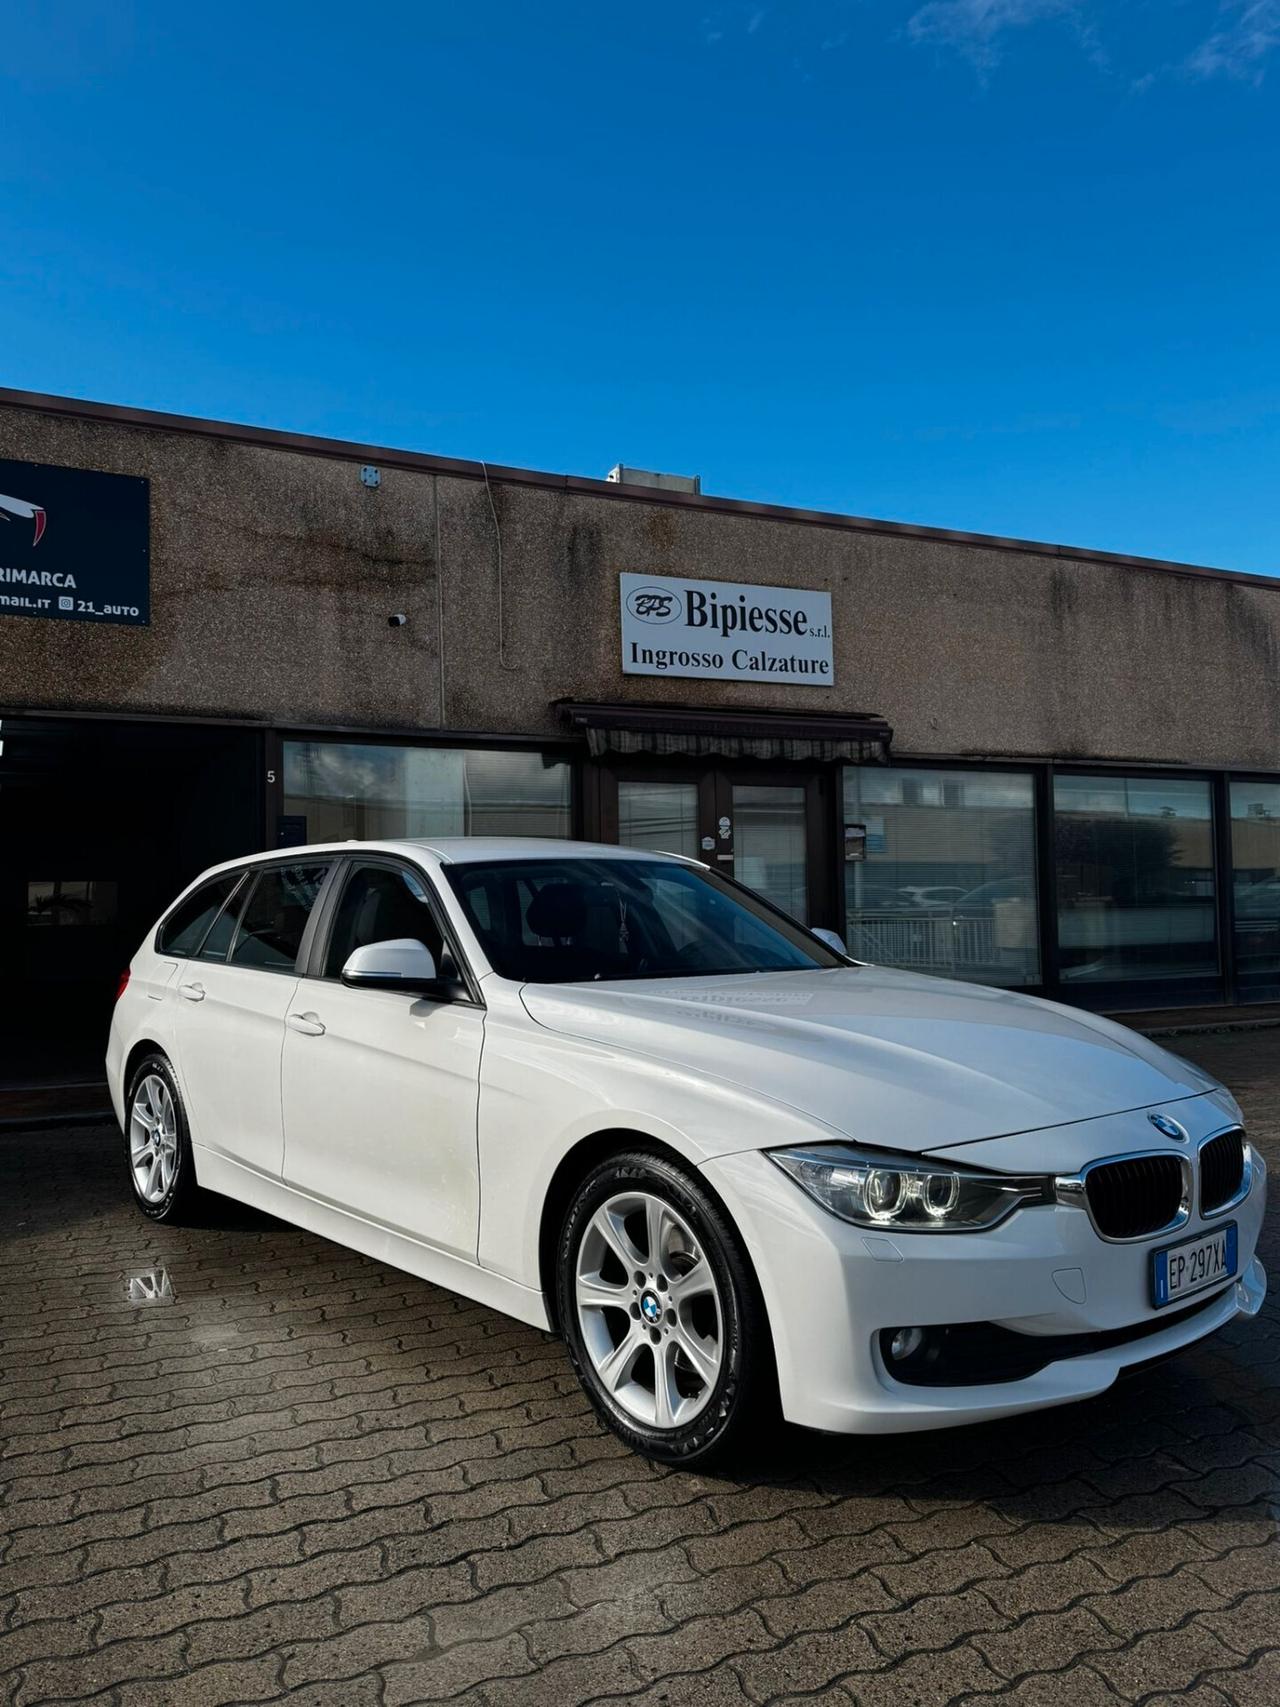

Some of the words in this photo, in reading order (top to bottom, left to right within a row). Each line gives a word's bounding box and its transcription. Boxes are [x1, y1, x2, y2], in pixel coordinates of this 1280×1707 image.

[684, 589, 808, 637] Bipiesse
[809, 625, 830, 638] s.r.l.
[630, 641, 724, 669] Ingrosso
[732, 649, 830, 674] Calzature
[266, 770, 276, 784] 5
[1170, 1256, 1186, 1290] EP
[1190, 1239, 1227, 1282] 297XA
